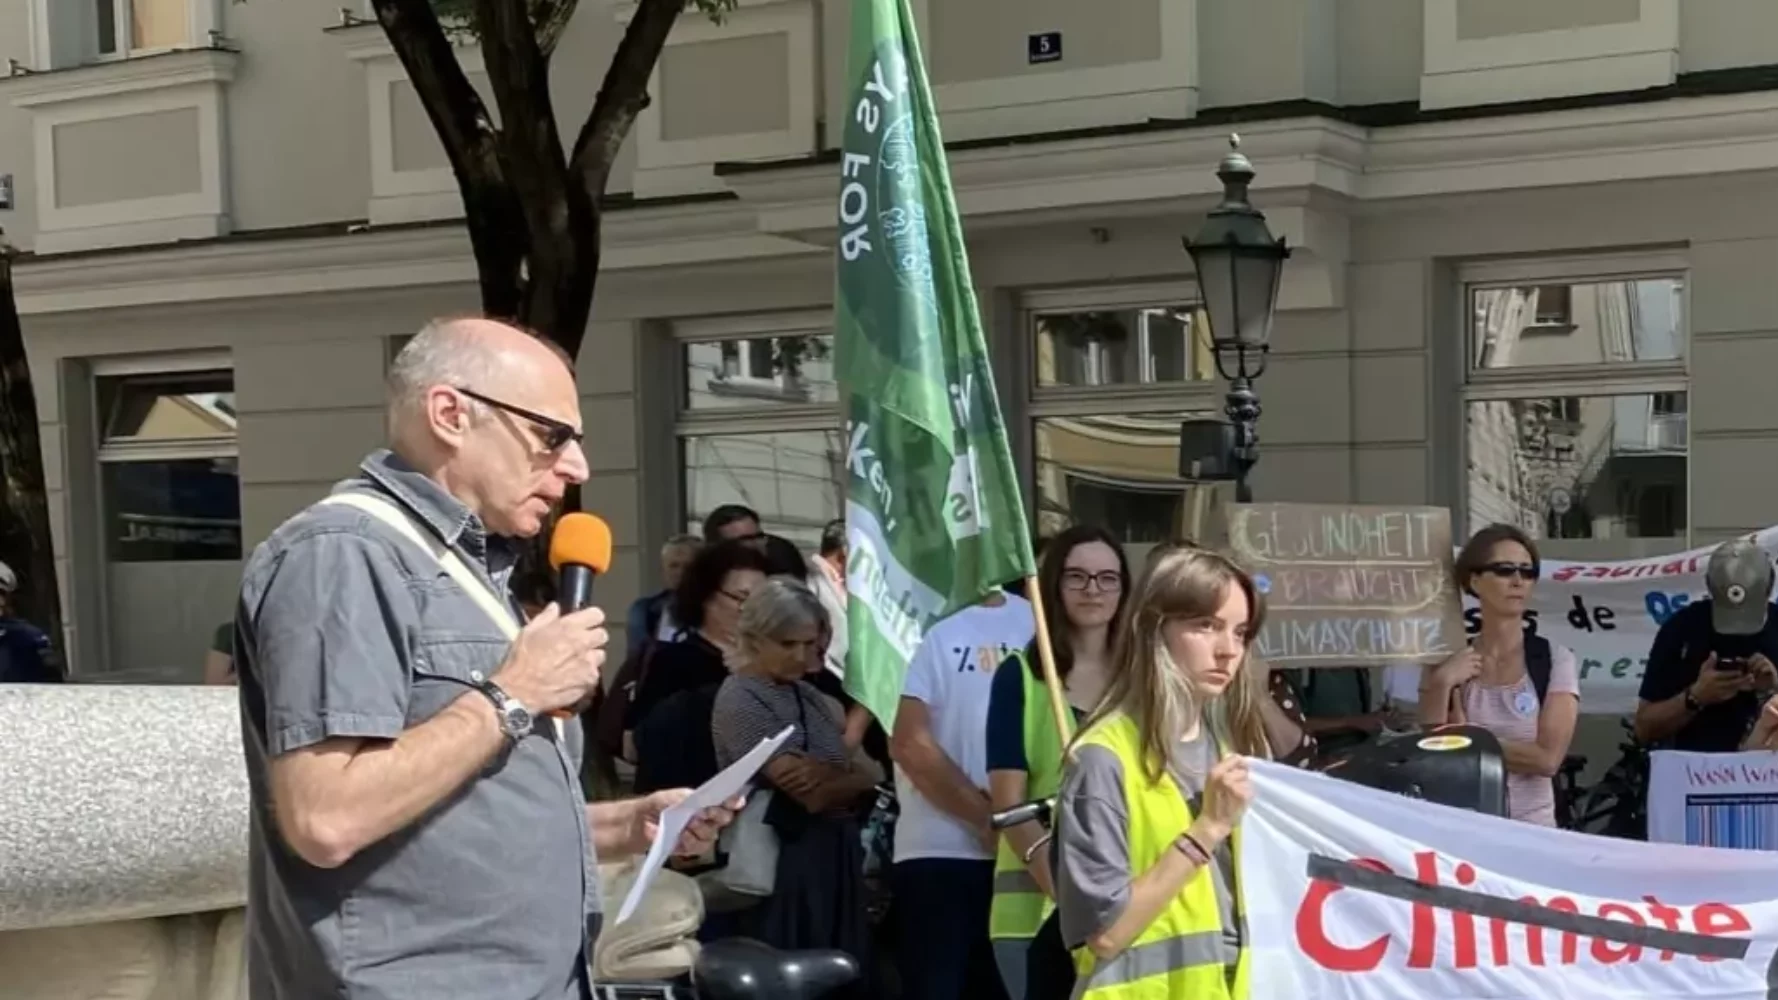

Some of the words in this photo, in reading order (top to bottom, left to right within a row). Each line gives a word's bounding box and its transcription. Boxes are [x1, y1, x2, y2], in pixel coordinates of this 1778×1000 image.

[1040, 36, 1050, 53] 5
[1279, 567, 1425, 602] BRAUCHT
[1295, 851, 1754, 972] Climate
